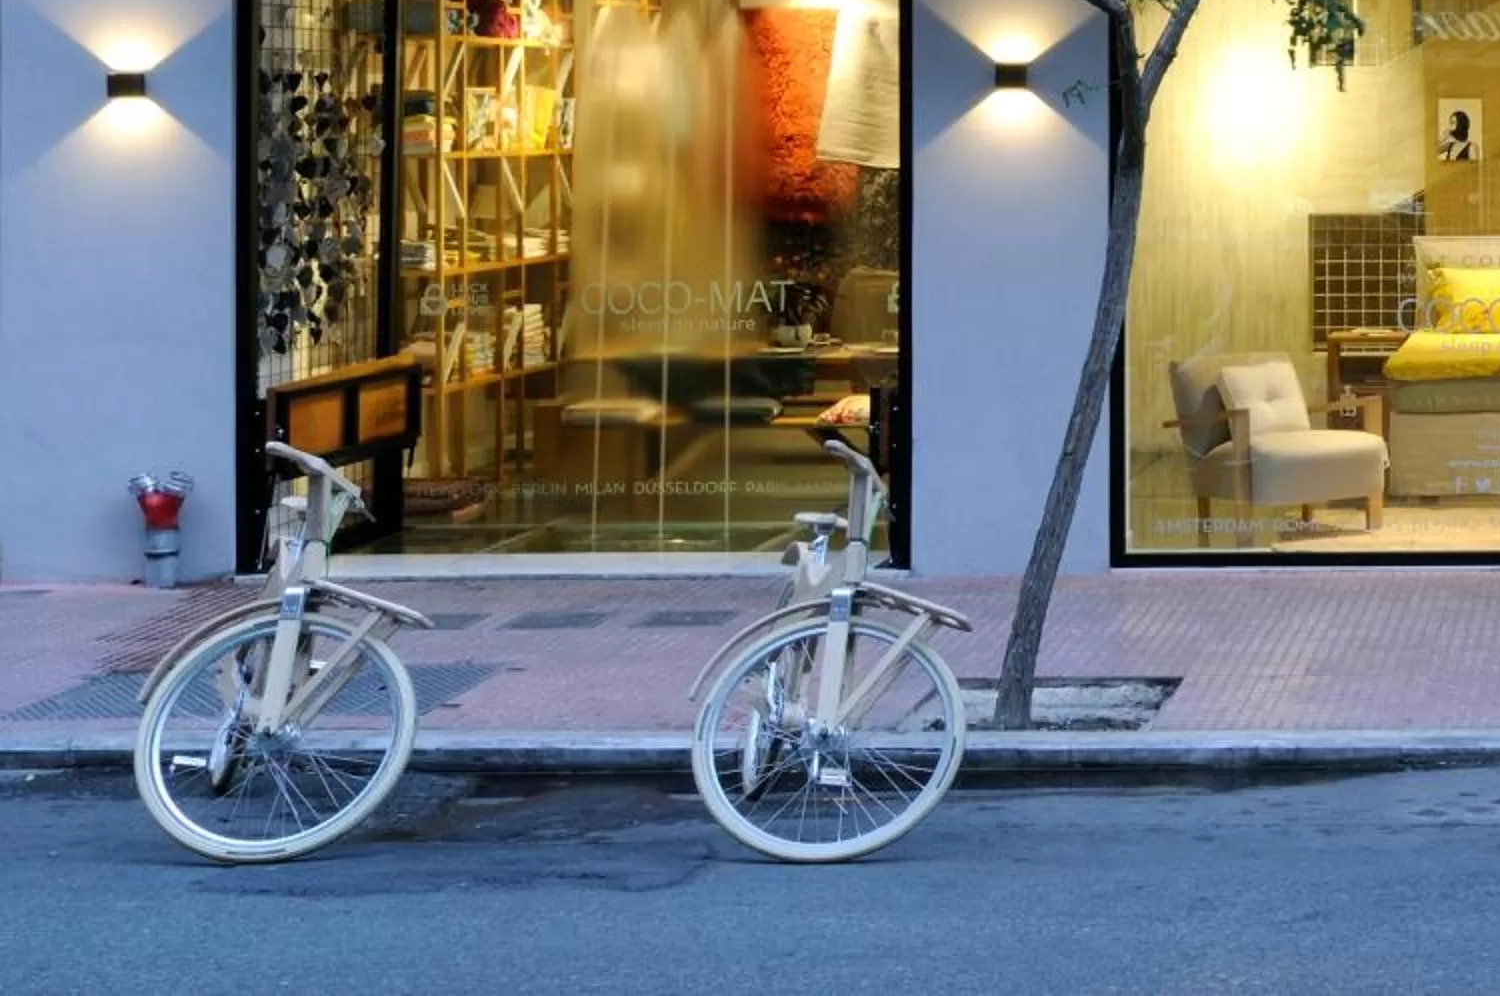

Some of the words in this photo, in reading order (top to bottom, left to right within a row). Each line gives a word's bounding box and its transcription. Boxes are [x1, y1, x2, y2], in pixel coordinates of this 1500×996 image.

[580, 280, 796, 315] COCO-MAT
[699, 317, 757, 332] nature
[575, 480, 627, 495] MILAN
